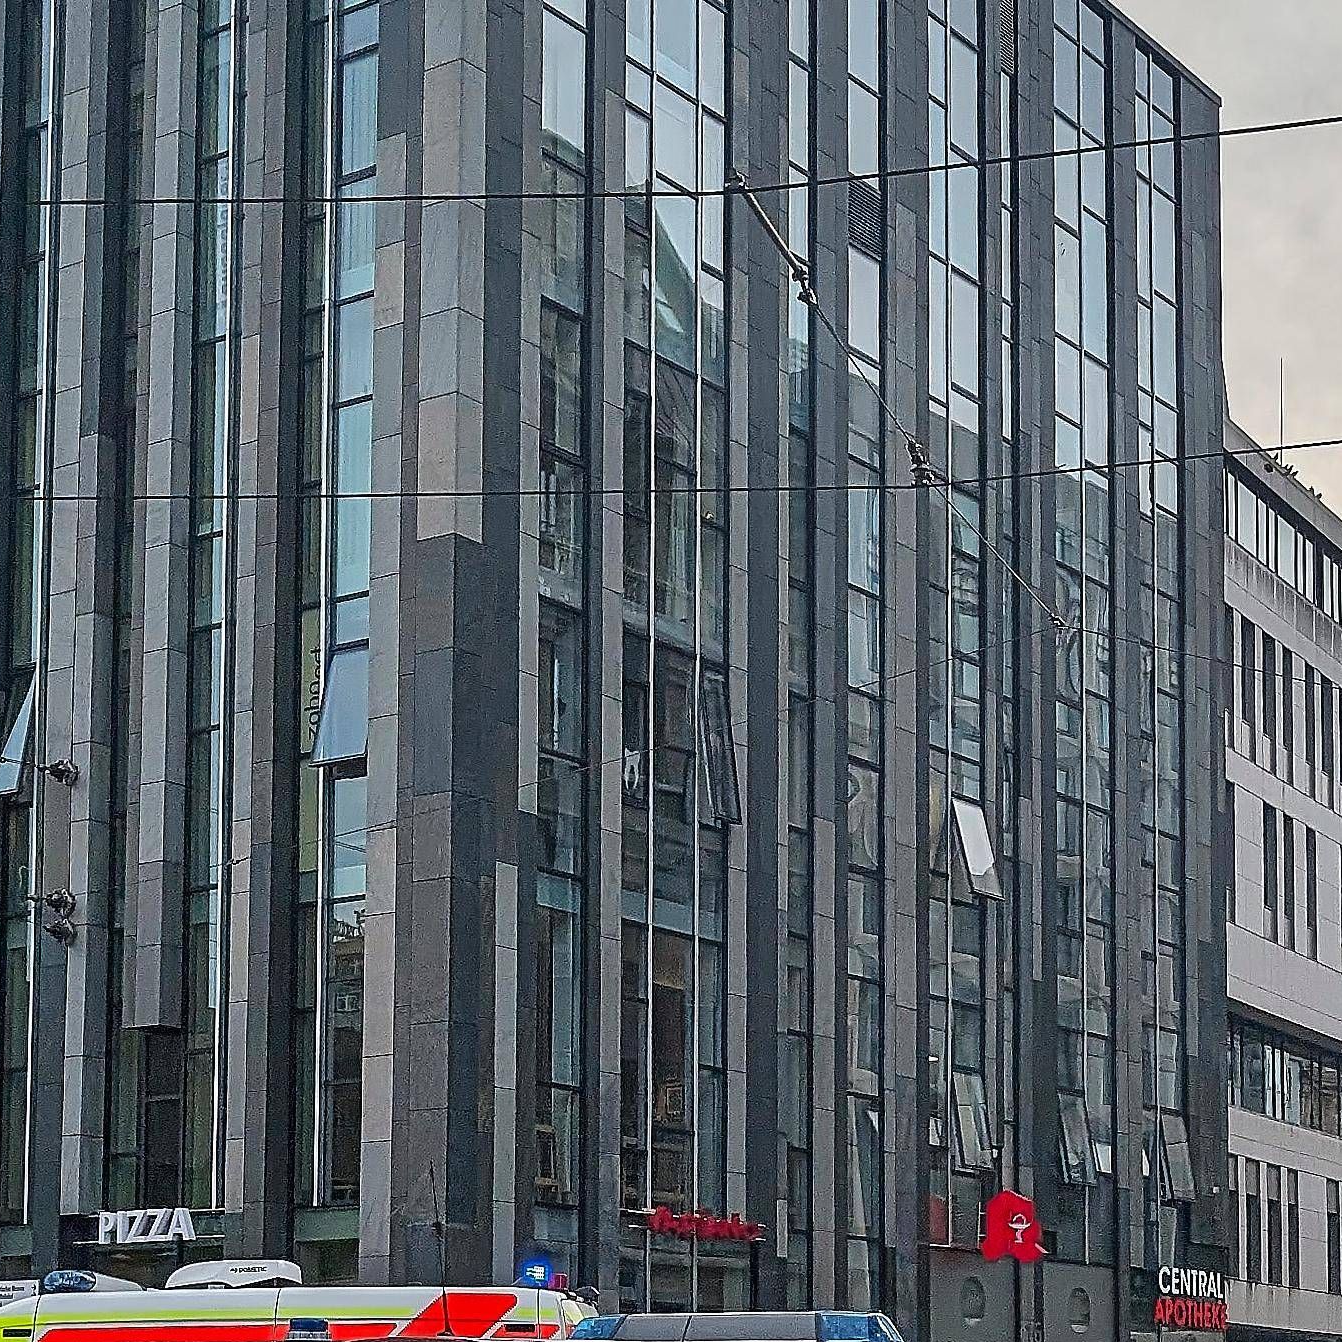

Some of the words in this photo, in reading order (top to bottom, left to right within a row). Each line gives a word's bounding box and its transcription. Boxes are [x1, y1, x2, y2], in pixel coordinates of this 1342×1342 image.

[98, 1207, 197, 1245] PIZZA
[1158, 1265, 1224, 1299] CENTRAL
[1154, 1297, 1229, 1330] APOTHEKE
